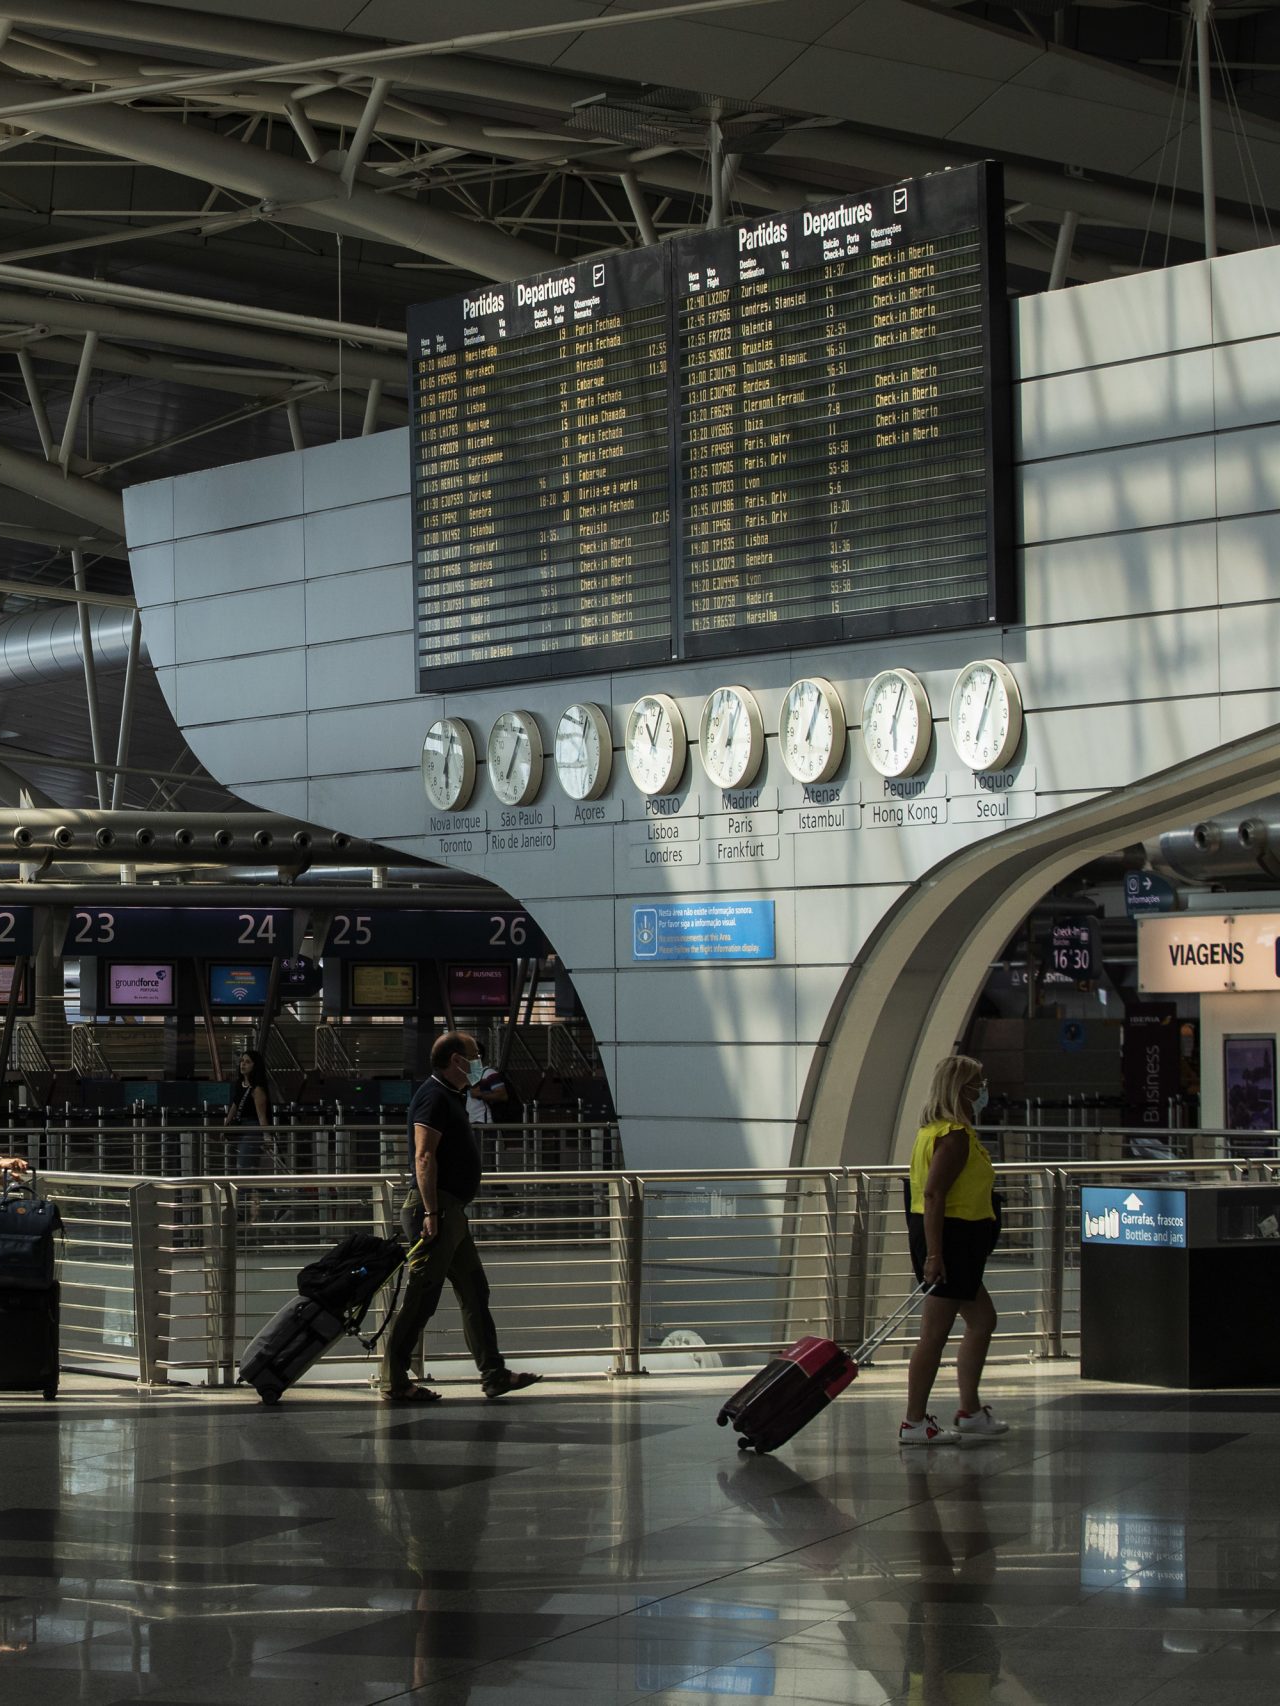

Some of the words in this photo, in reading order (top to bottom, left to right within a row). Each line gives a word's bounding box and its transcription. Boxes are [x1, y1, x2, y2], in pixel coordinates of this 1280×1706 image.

[738, 220, 787, 251] Partidas
[803, 202, 872, 237] Departures
[780, 249, 789, 259] Via
[741, 282, 767, 298] Zurique
[872, 250, 904, 269] Check-in
[908, 243, 934, 261] Aberto
[781, 261, 789, 270] Via
[775, 291, 806, 310] Stansted
[872, 270, 905, 288] Check-in
[909, 263, 934, 281] Aberto
[463, 292, 504, 320] Partidas
[517, 276, 575, 307] Departures
[742, 318, 772, 336] Valencia
[873, 290, 905, 308] Check-in
[909, 283, 934, 301] Aberto
[575, 322, 592, 336] Porta
[595, 316, 620, 332] Fechada
[576, 340, 592, 355] Porta
[596, 334, 620, 350] Fechada
[742, 338, 772, 355] Bruxelas
[777, 388, 804, 406] Ferrand
[744, 417, 763, 431] Ibiza
[579, 502, 606, 517] Check-in
[745, 532, 768, 546] Lisboa
[745, 550, 772, 565] Genebra
[746, 589, 773, 604] Madeira
[803, 787, 840, 803] Atenas
[884, 778, 926, 798] Pequim
[646, 798, 680, 815] PORTO
[722, 792, 759, 810] Madrid
[977, 798, 1009, 817] Seoul
[501, 812, 516, 827] São
[519, 810, 543, 825] Paulo
[575, 805, 605, 824] Açores
[799, 809, 845, 829] Istambul
[873, 806, 903, 826] Hong
[908, 803, 938, 824] Kong
[430, 817, 451, 832] Nova
[647, 822, 679, 840] Lisboa
[728, 816, 753, 833] Paris
[439, 838, 473, 853] Toronto
[491, 835, 506, 850] Rio
[507, 834, 519, 849] de
[520, 833, 552, 848] Janeiro
[718, 841, 764, 859] Frankfurt
[645, 848, 683, 864] Londres
[74, 912, 115, 944] 23
[237, 914, 277, 944] 24
[333, 915, 372, 945] 25
[489, 916, 527, 945] 26
[1053, 949, 1068, 969] 16
[1073, 949, 1090, 969] 30
[1169, 942, 1244, 966] VIAGENS
[115, 978, 160, 988] groundforce
[1143, 1044, 1160, 1123] Business
[1121, 1213, 1155, 1227] Garrafas,
[1157, 1214, 1183, 1227] frascos
[1125, 1229, 1152, 1241] Bottles
[1153, 1231, 1168, 1242] and
[1169, 1233, 1183, 1244] jars
